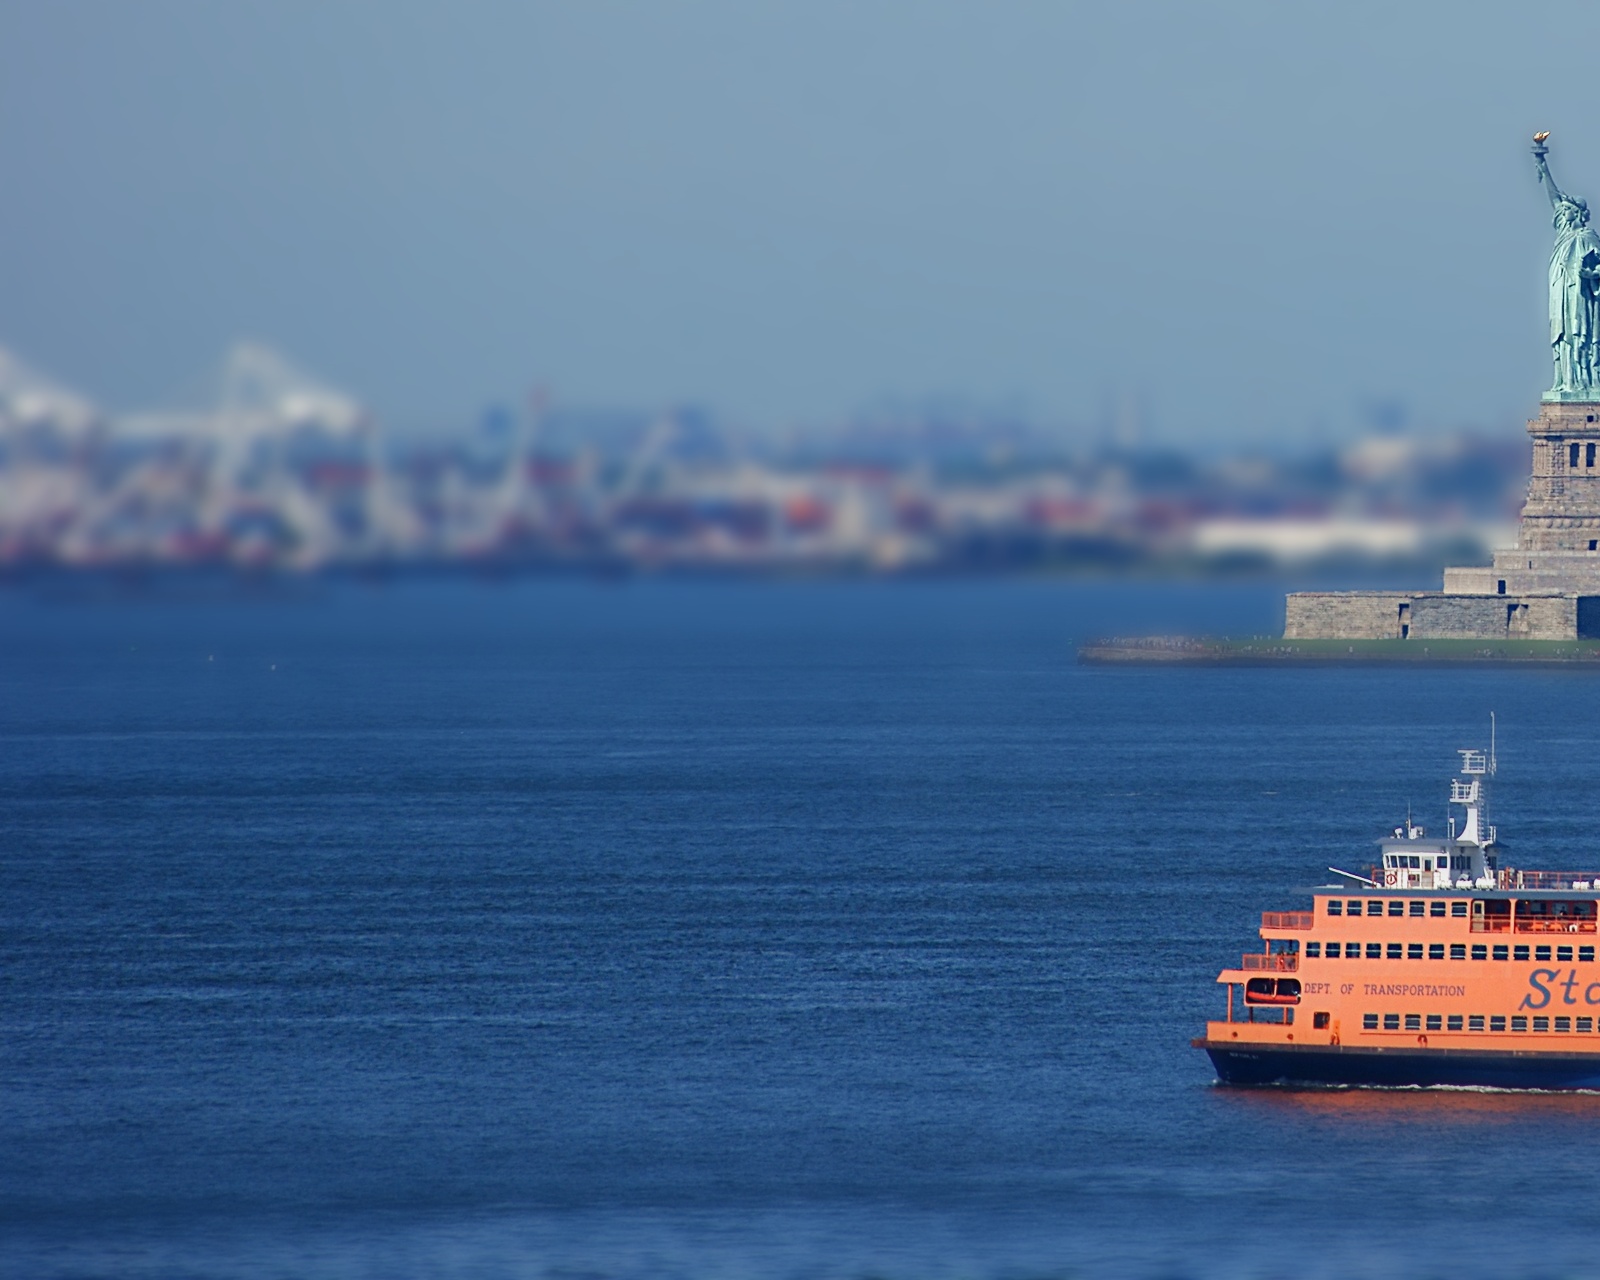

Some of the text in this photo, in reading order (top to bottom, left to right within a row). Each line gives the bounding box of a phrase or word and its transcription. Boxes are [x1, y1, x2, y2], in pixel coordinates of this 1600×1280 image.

[1304, 983, 1465, 996] DEPT. OF TRANSPORTATION
